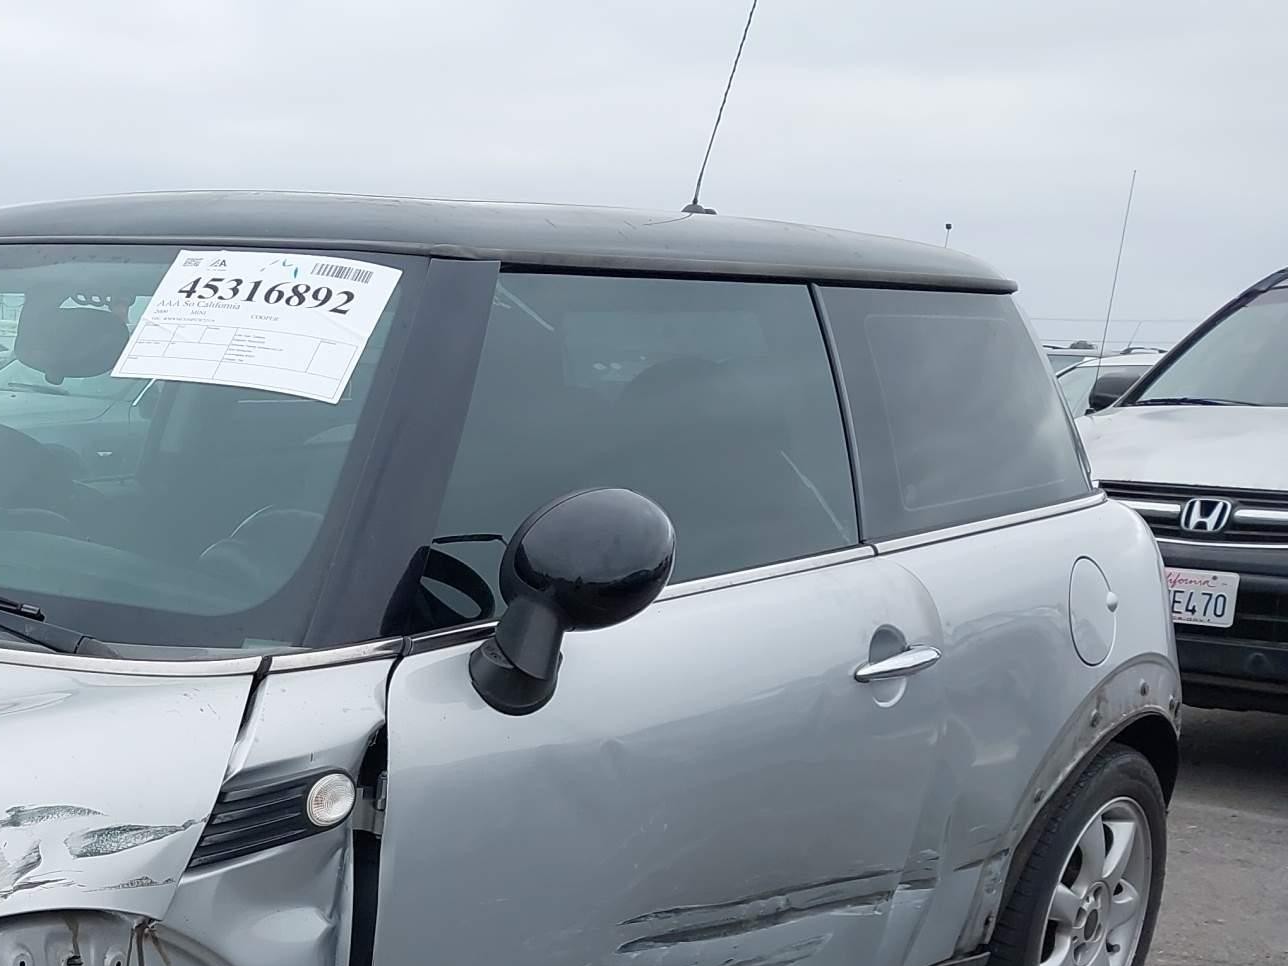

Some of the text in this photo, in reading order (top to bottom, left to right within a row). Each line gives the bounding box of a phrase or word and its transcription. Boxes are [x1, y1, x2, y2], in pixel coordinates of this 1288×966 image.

[156, 300, 180, 308] AAA
[196, 301, 241, 310] California
[177, 276, 355, 315] 45316892
[1167, 572, 1216, 588] lifornia
[1168, 590, 1227, 617] E470
